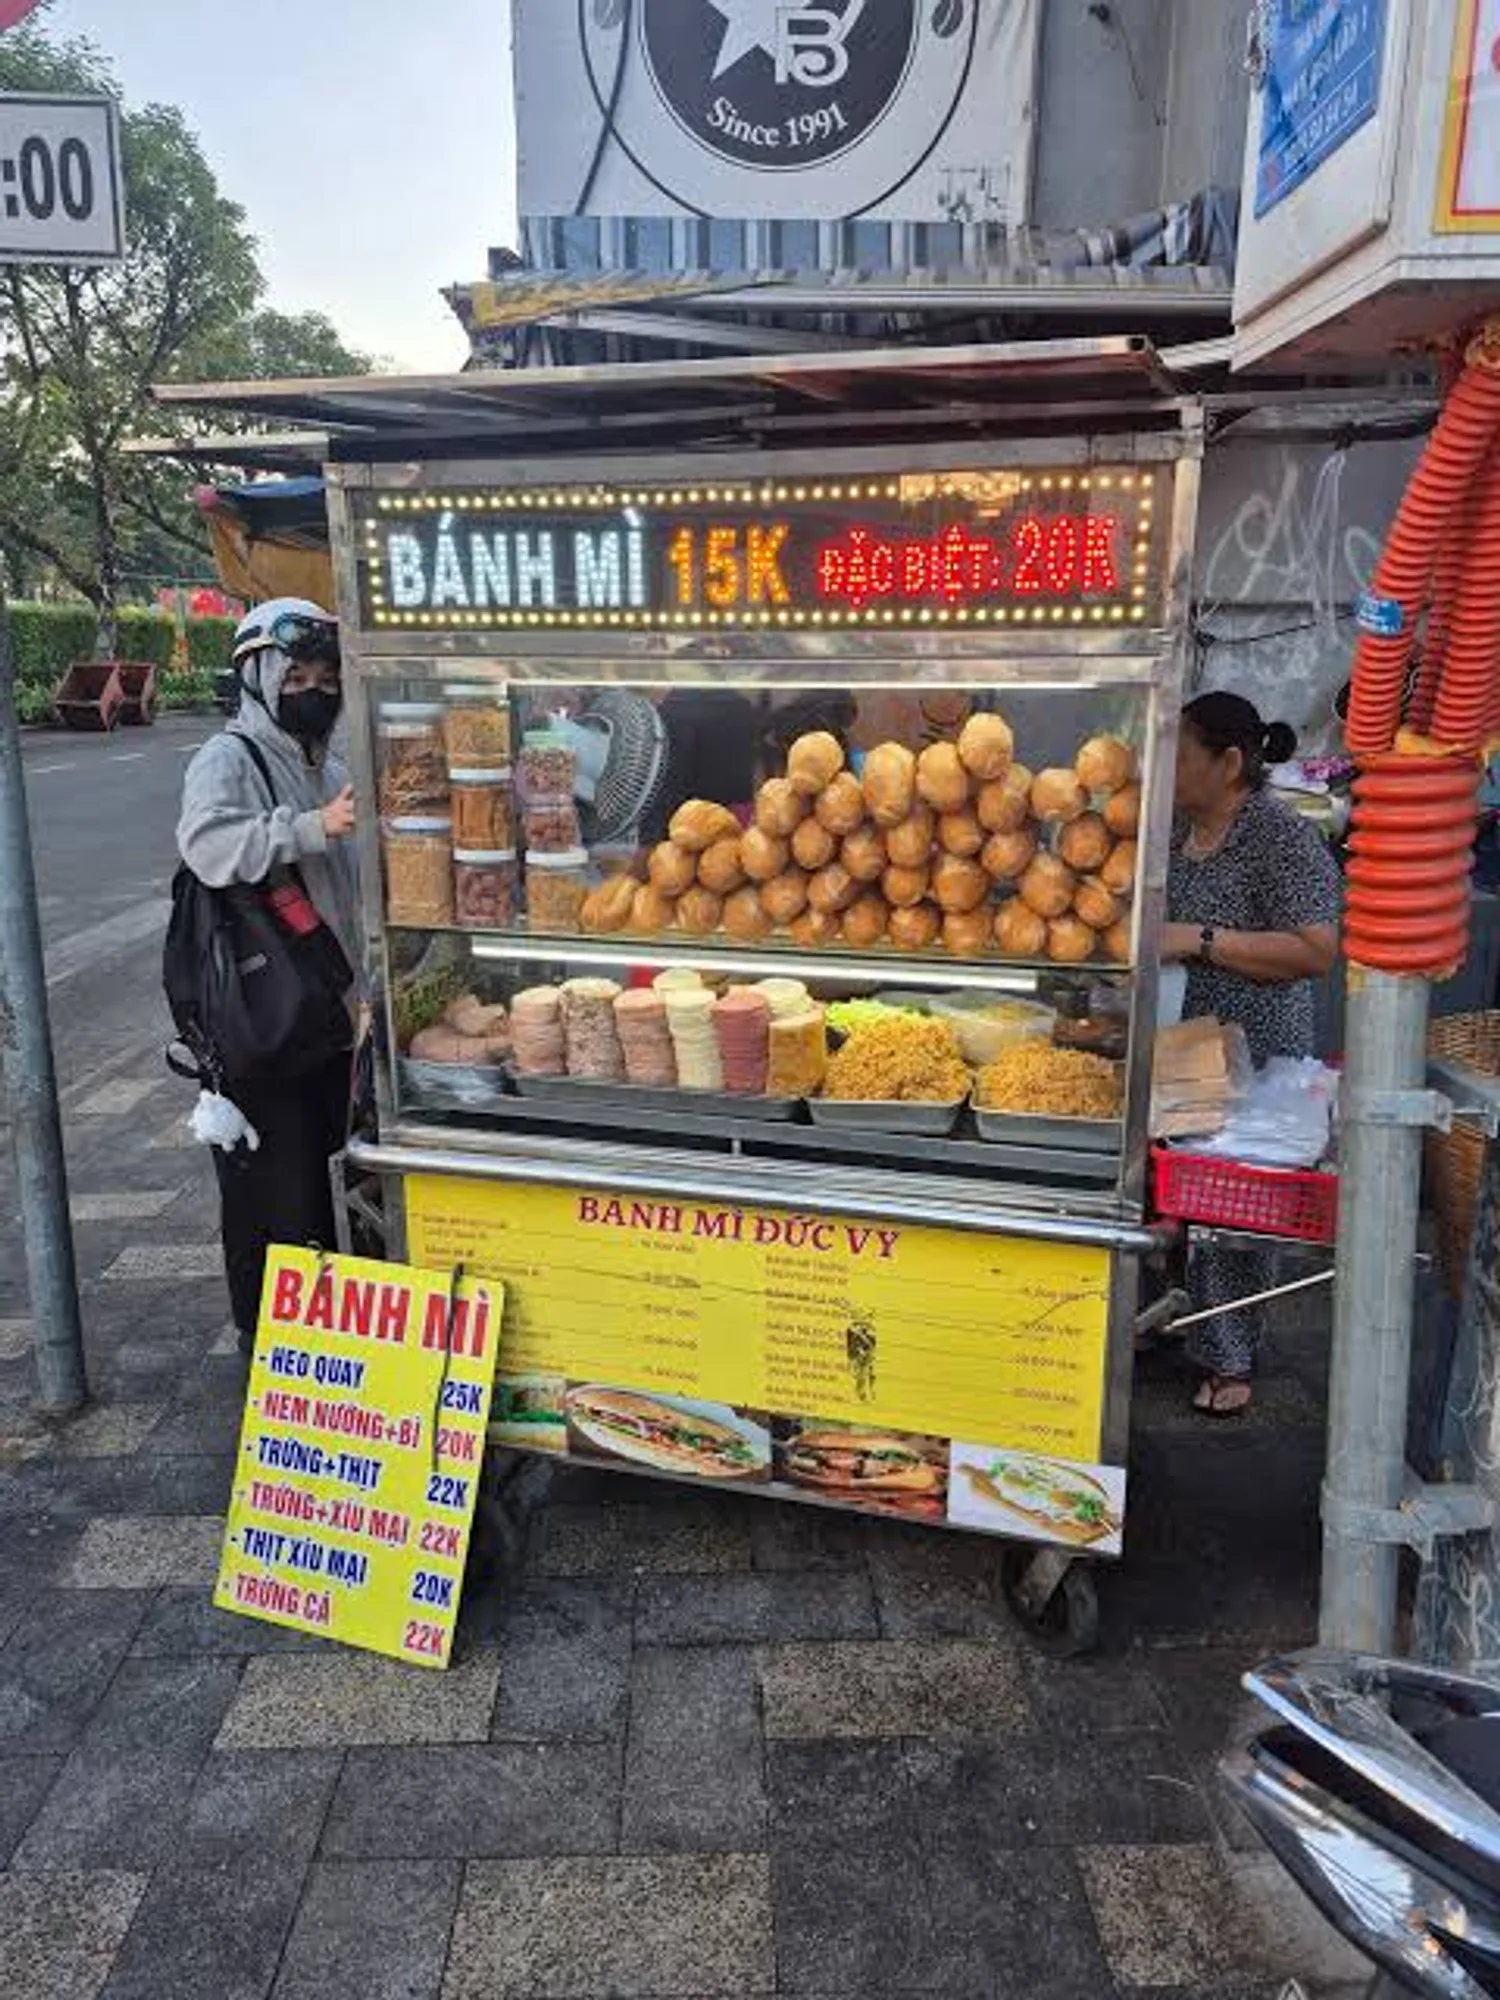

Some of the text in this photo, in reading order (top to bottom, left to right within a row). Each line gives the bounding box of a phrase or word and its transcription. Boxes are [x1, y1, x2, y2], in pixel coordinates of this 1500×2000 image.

[706, 96, 849, 147] Since 1991
[387, 506, 1118, 608] BÁNH MÌ 15K ĐẶC BIỆT: 20K
[577, 1194, 900, 1259] BÁNH MÌ ĐỨC VY
[271, 1263, 411, 1343] BÁNH
[421, 1287, 490, 1358] MÌ
[270, 1346, 484, 1413] HEO QUAY 25K
[263, 1390, 310, 1425] NEM
[435, 1427, 477, 1461] 20K
[427, 1474, 469, 1509] 22K
[242, 1527, 454, 1608] THỊT XÍU MẠI 20K
[367, 1508, 411, 1548] MẠI
[418, 1520, 462, 1558] 22K
[235, 1572, 446, 1657] TRỨNG CÁ 22K
